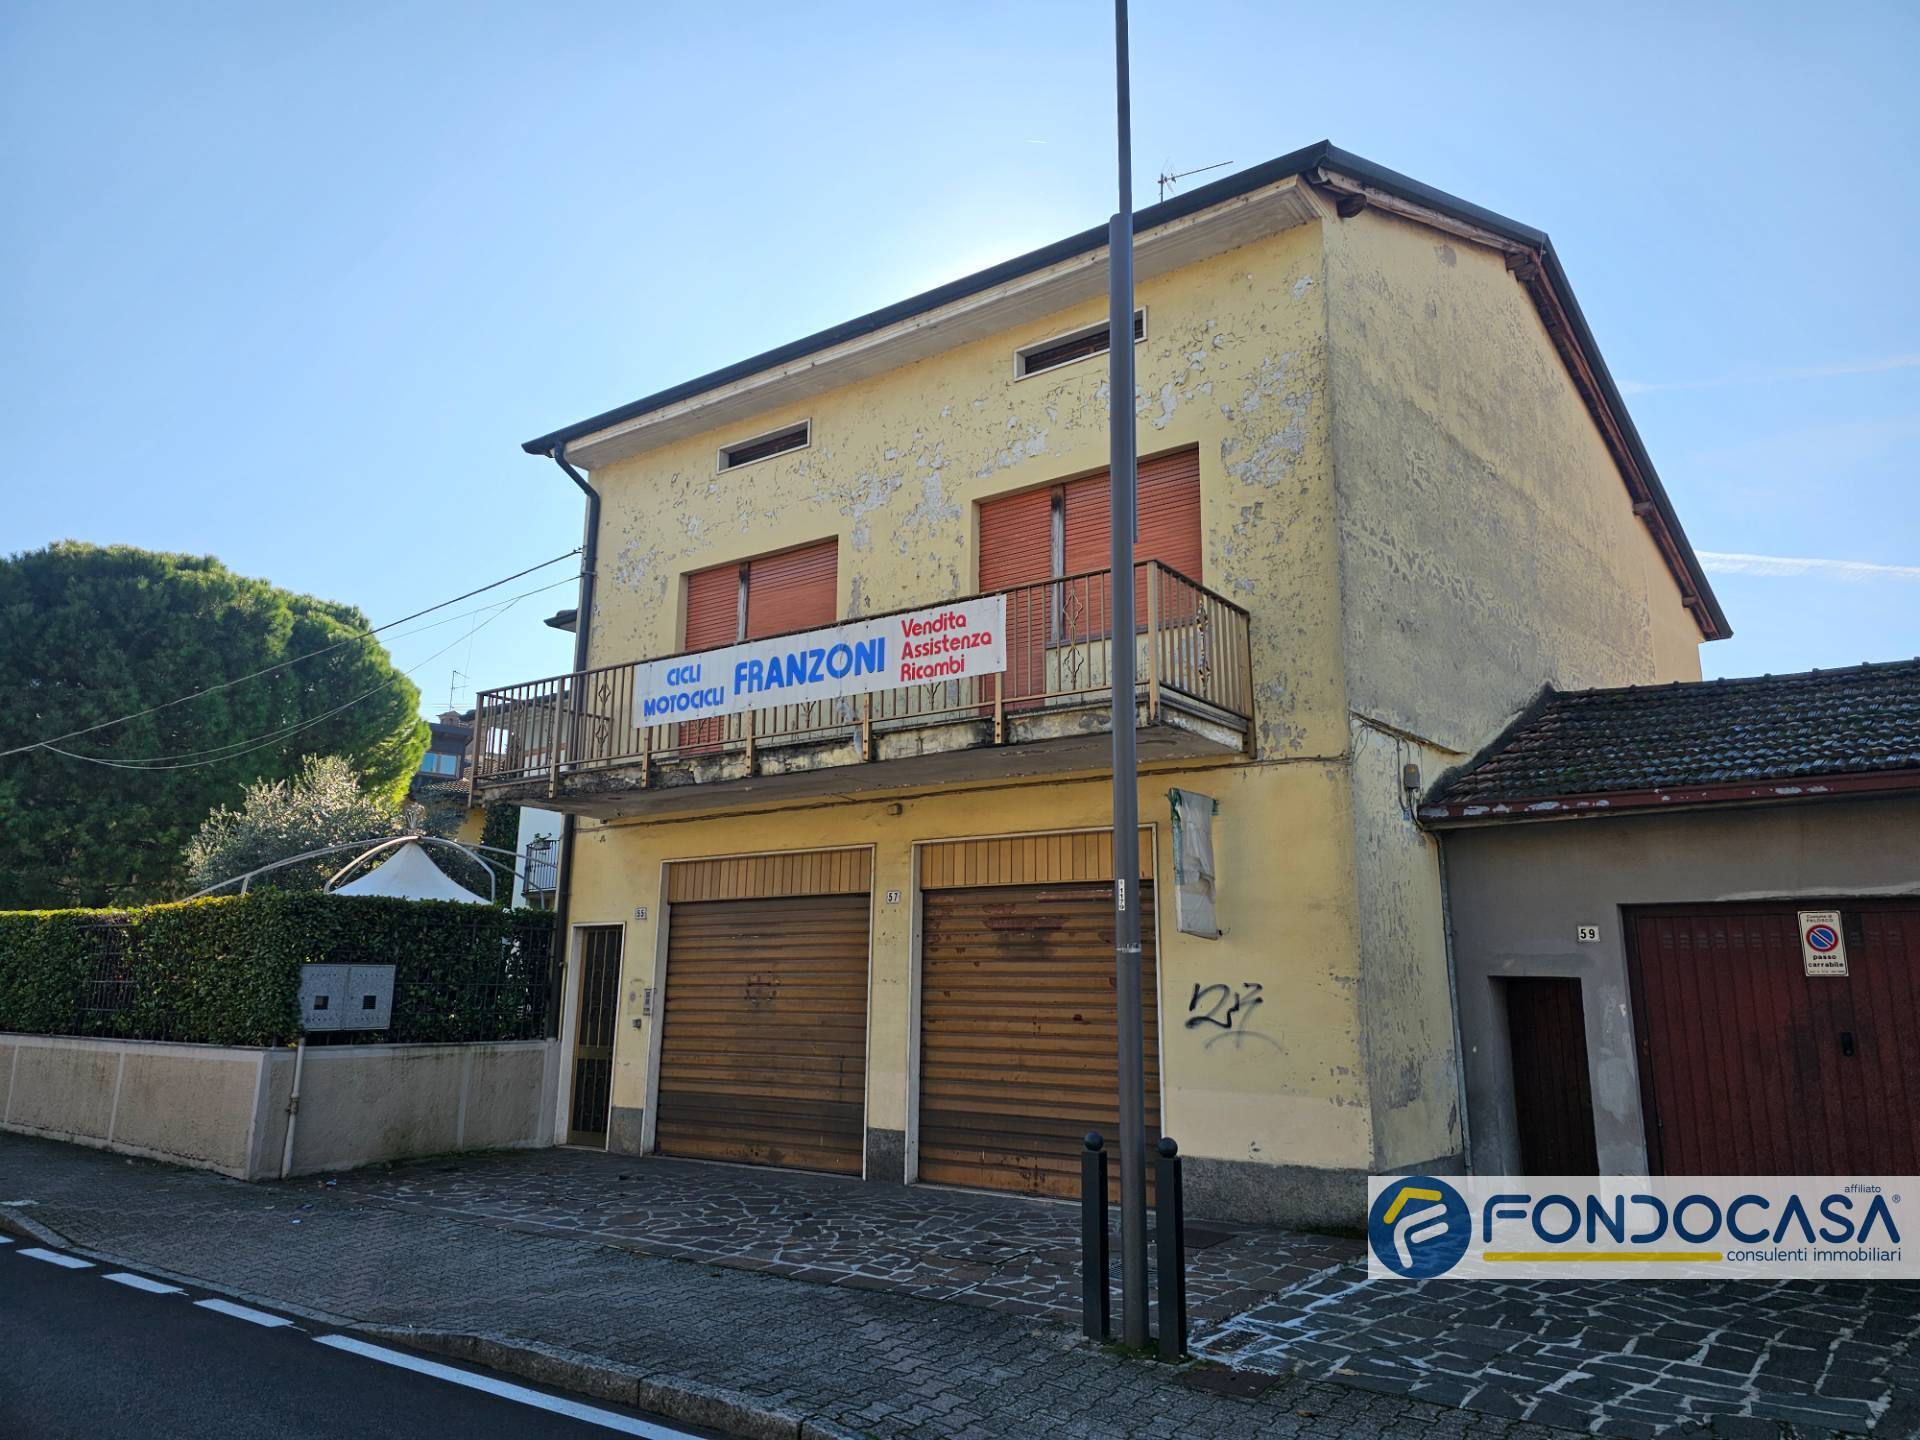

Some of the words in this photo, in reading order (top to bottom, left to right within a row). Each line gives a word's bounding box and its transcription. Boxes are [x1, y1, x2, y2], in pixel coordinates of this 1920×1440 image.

[902, 611, 967, 638] Vendita
[901, 631, 992, 660] Assistenza
[667, 664, 701, 686] CICLI
[734, 637, 885, 695] FRANZONI
[901, 655, 965, 682] Ricambi
[644, 686, 724, 716] MOTOCICLI
[888, 892, 898, 901] 57
[1580, 928, 1595, 939] 59
